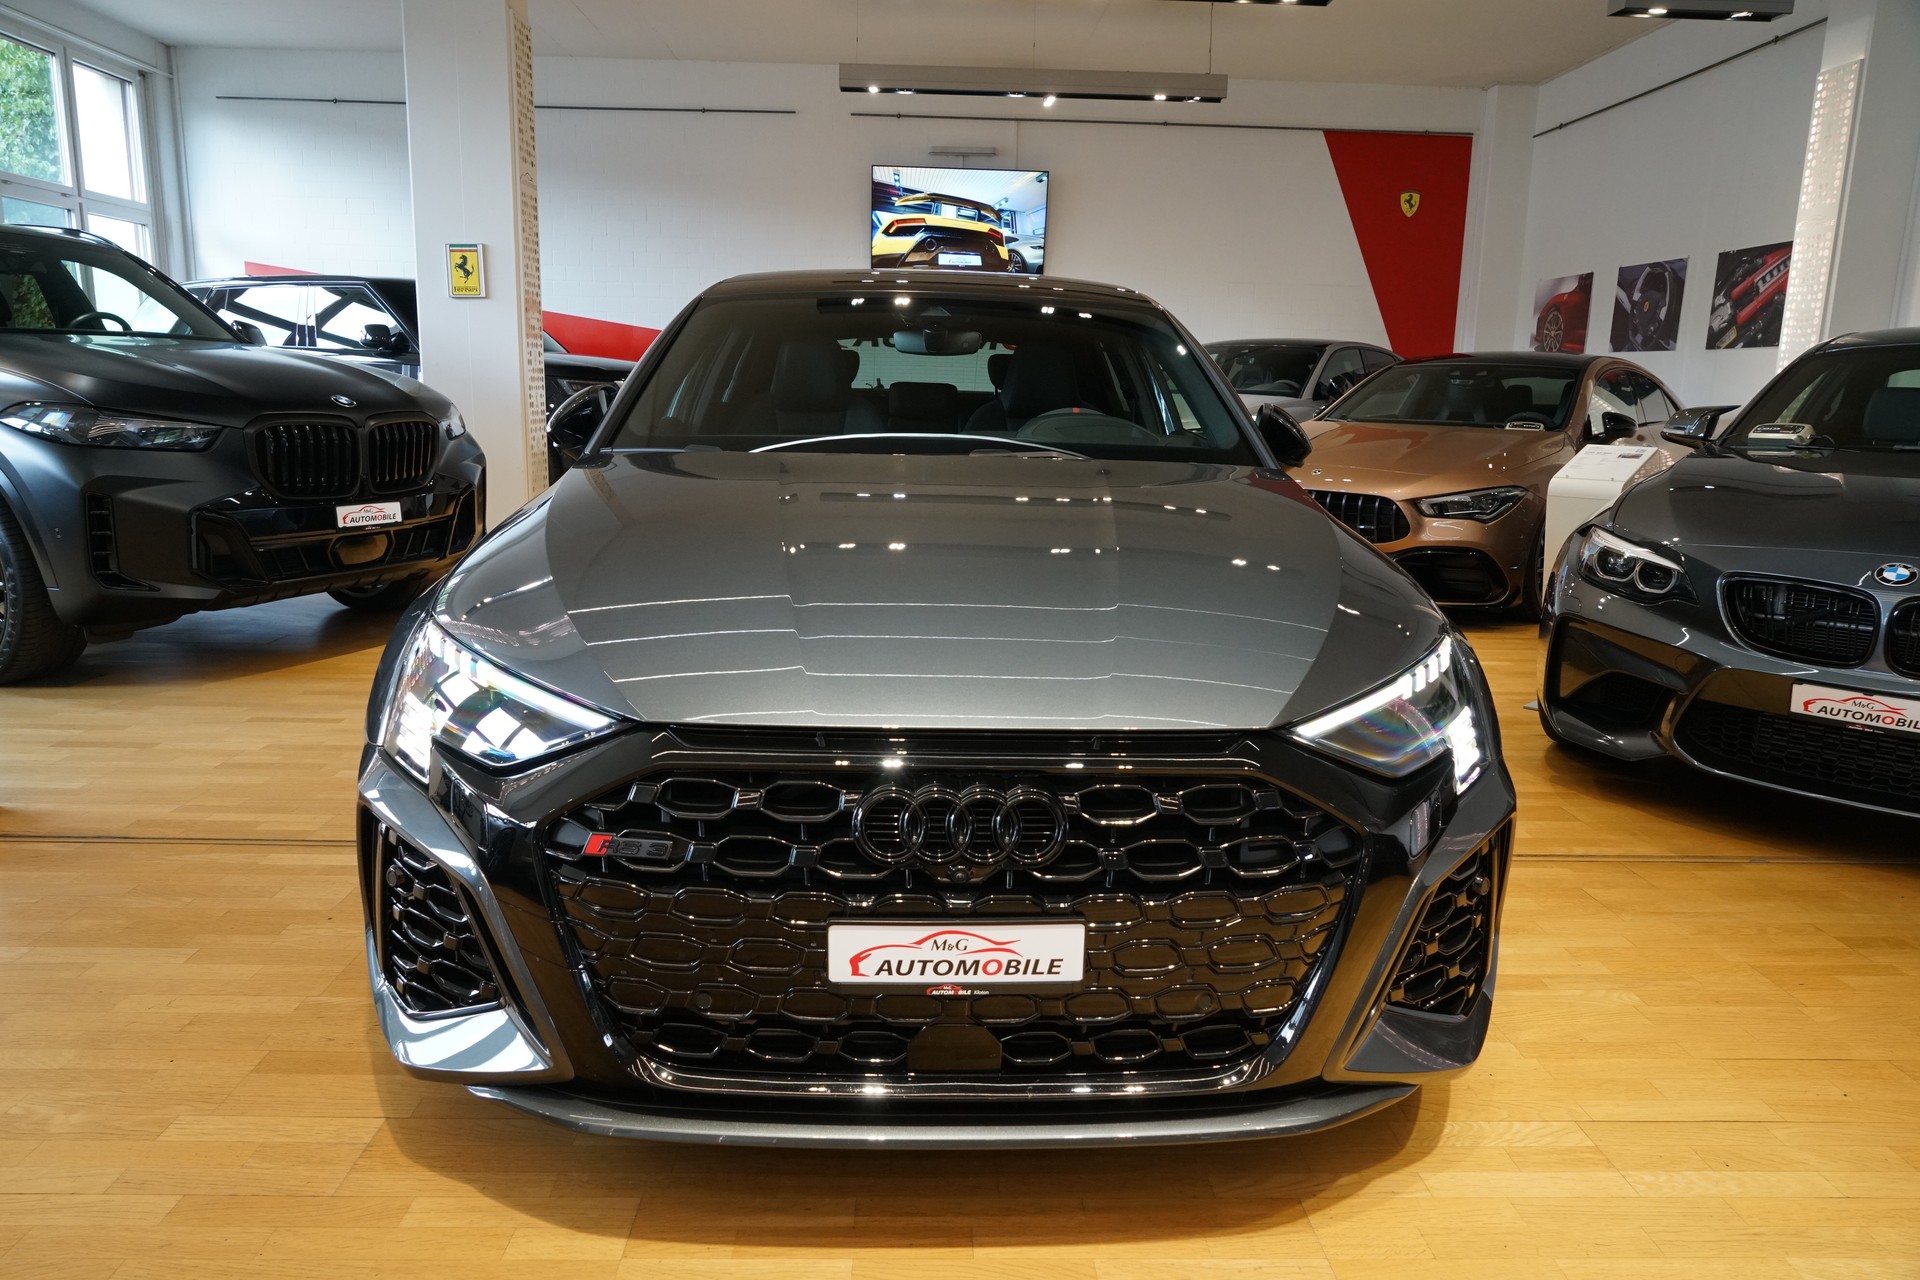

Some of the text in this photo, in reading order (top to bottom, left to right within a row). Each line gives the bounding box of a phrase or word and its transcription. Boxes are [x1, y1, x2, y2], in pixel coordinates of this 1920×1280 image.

[350, 513, 397, 524] AUTOMOBILE
[598, 840, 669, 856] RS 3
[931, 938, 969, 951] M&G
[874, 958, 1064, 976] AUTOMOBILE
